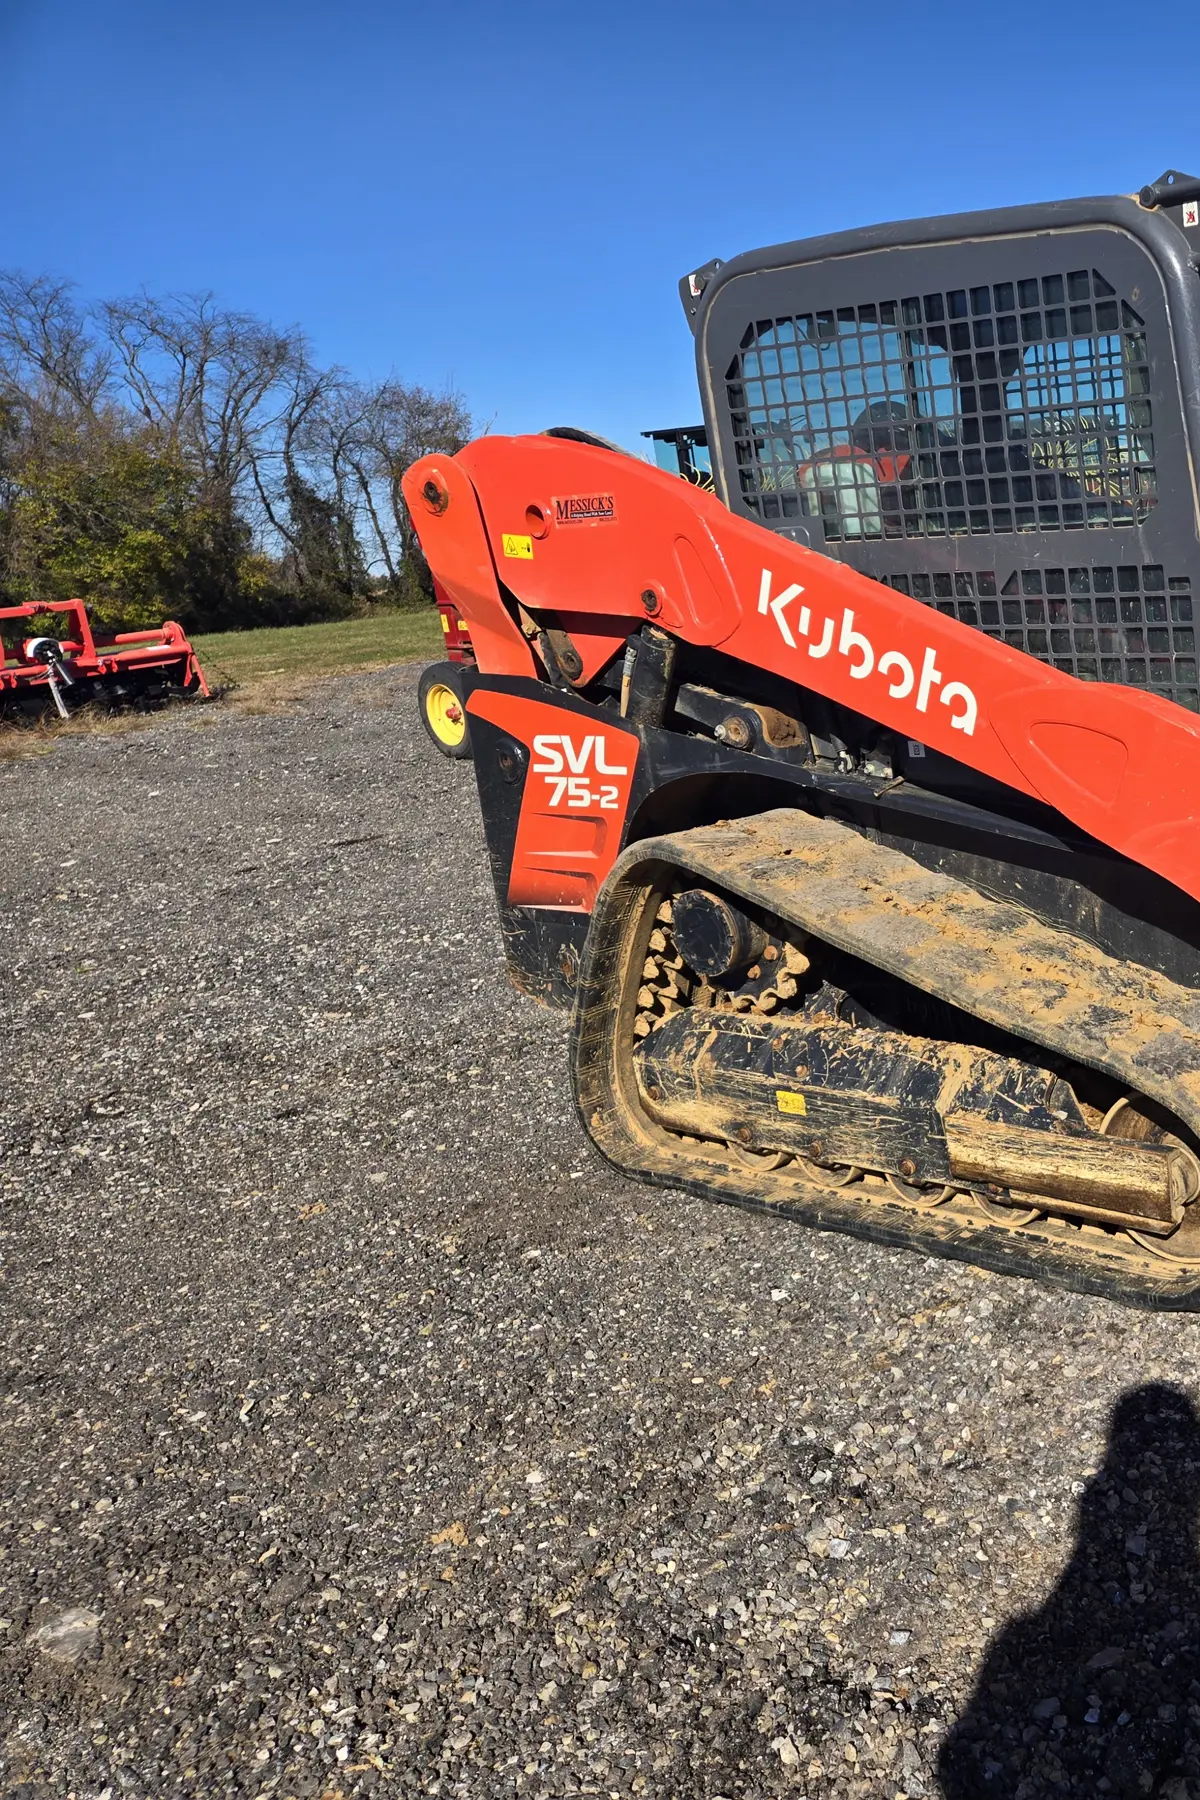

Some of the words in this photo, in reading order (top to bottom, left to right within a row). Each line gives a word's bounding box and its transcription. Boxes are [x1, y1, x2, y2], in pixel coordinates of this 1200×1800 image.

[556, 496, 613, 520] MESSICK'S
[757, 568, 978, 736] Kubota
[533, 735, 627, 775] SVL
[544, 776, 618, 809] 75-2
